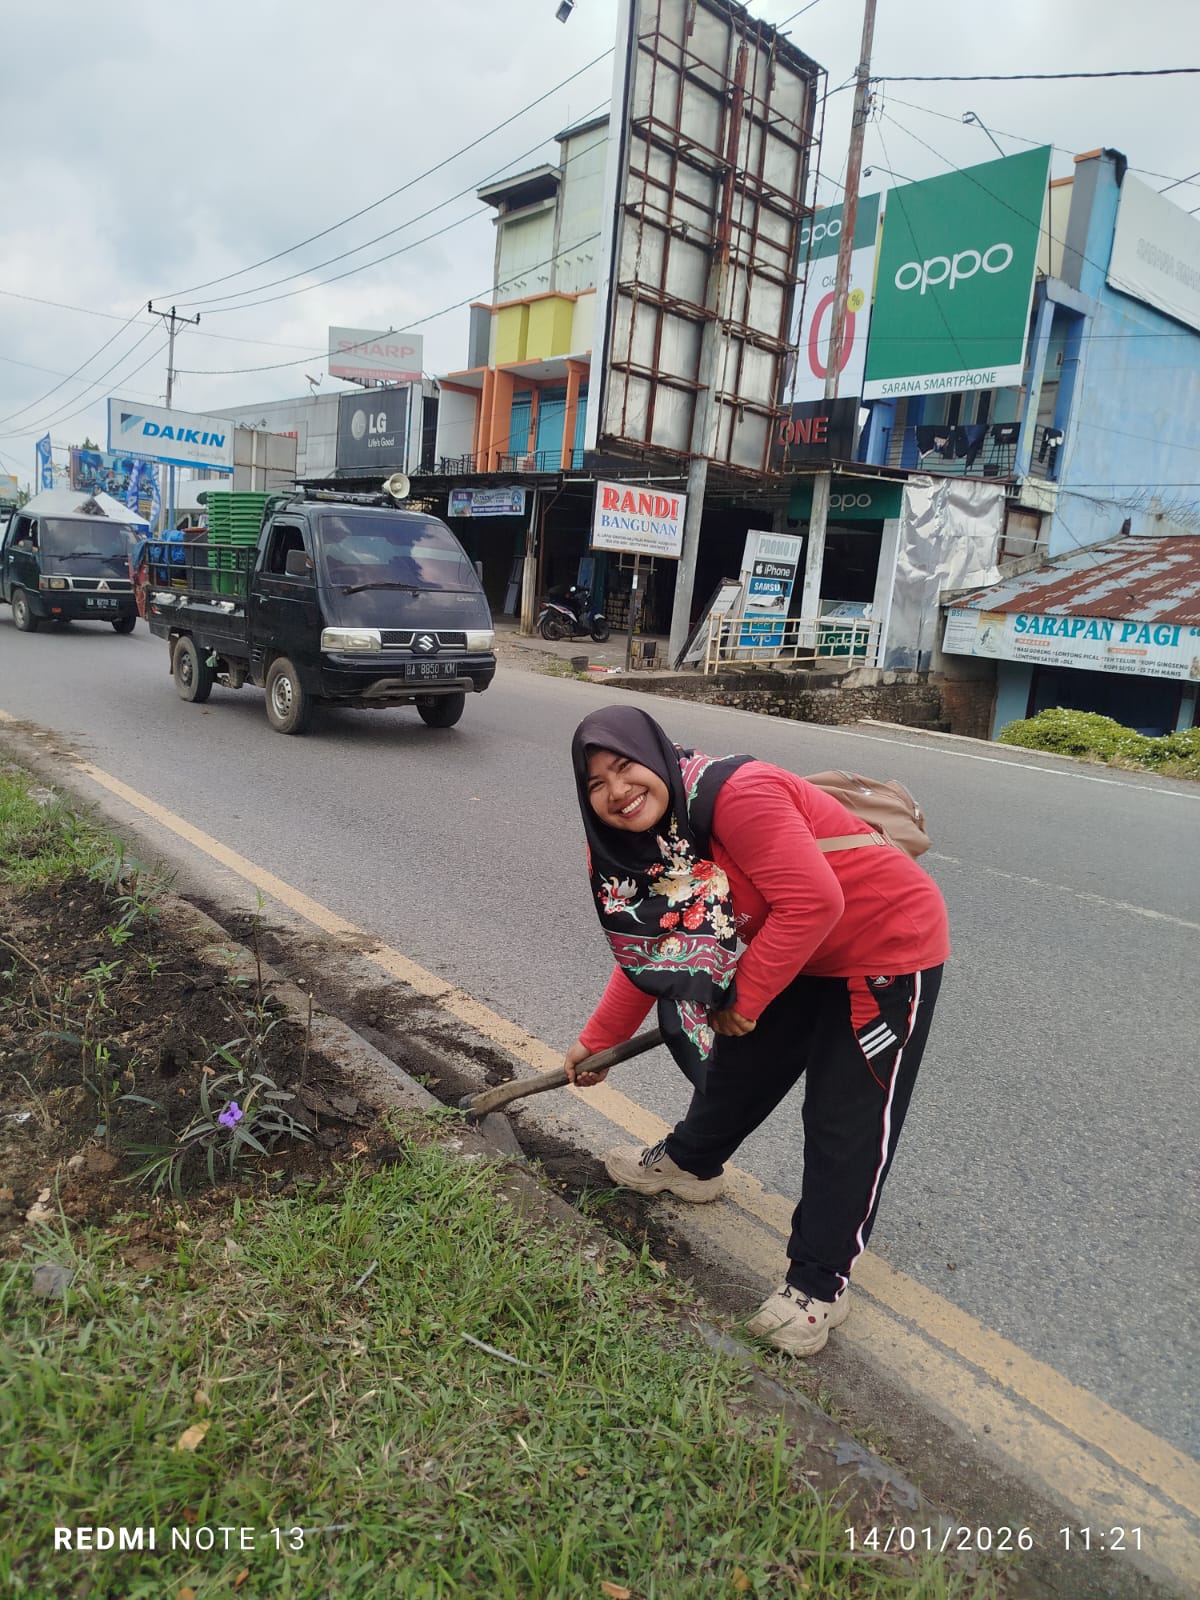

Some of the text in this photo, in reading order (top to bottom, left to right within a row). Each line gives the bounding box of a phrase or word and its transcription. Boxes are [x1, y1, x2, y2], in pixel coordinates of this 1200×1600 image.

[800, 219, 842, 247] ppo
[895, 243, 1014, 295] oppo
[338, 341, 415, 358] SHARP
[882, 372, 997, 394] SARANA SMARTPHONE
[369, 412, 387, 434] LG
[143, 422, 226, 448] DAIKIN
[368, 437, 395, 448] Life's Good
[602, 486, 679, 520] RANDI
[827, 493, 872, 512] ppo
[601, 514, 678, 537] BANGUNAN
[759, 538, 790, 556] PROMO
[764, 564, 791, 577] iPhone
[1014, 614, 1114, 641] SARAPAN
[1120, 622, 1182, 647] PAGI
[406, 663, 456, 675] BA 8850 KM
